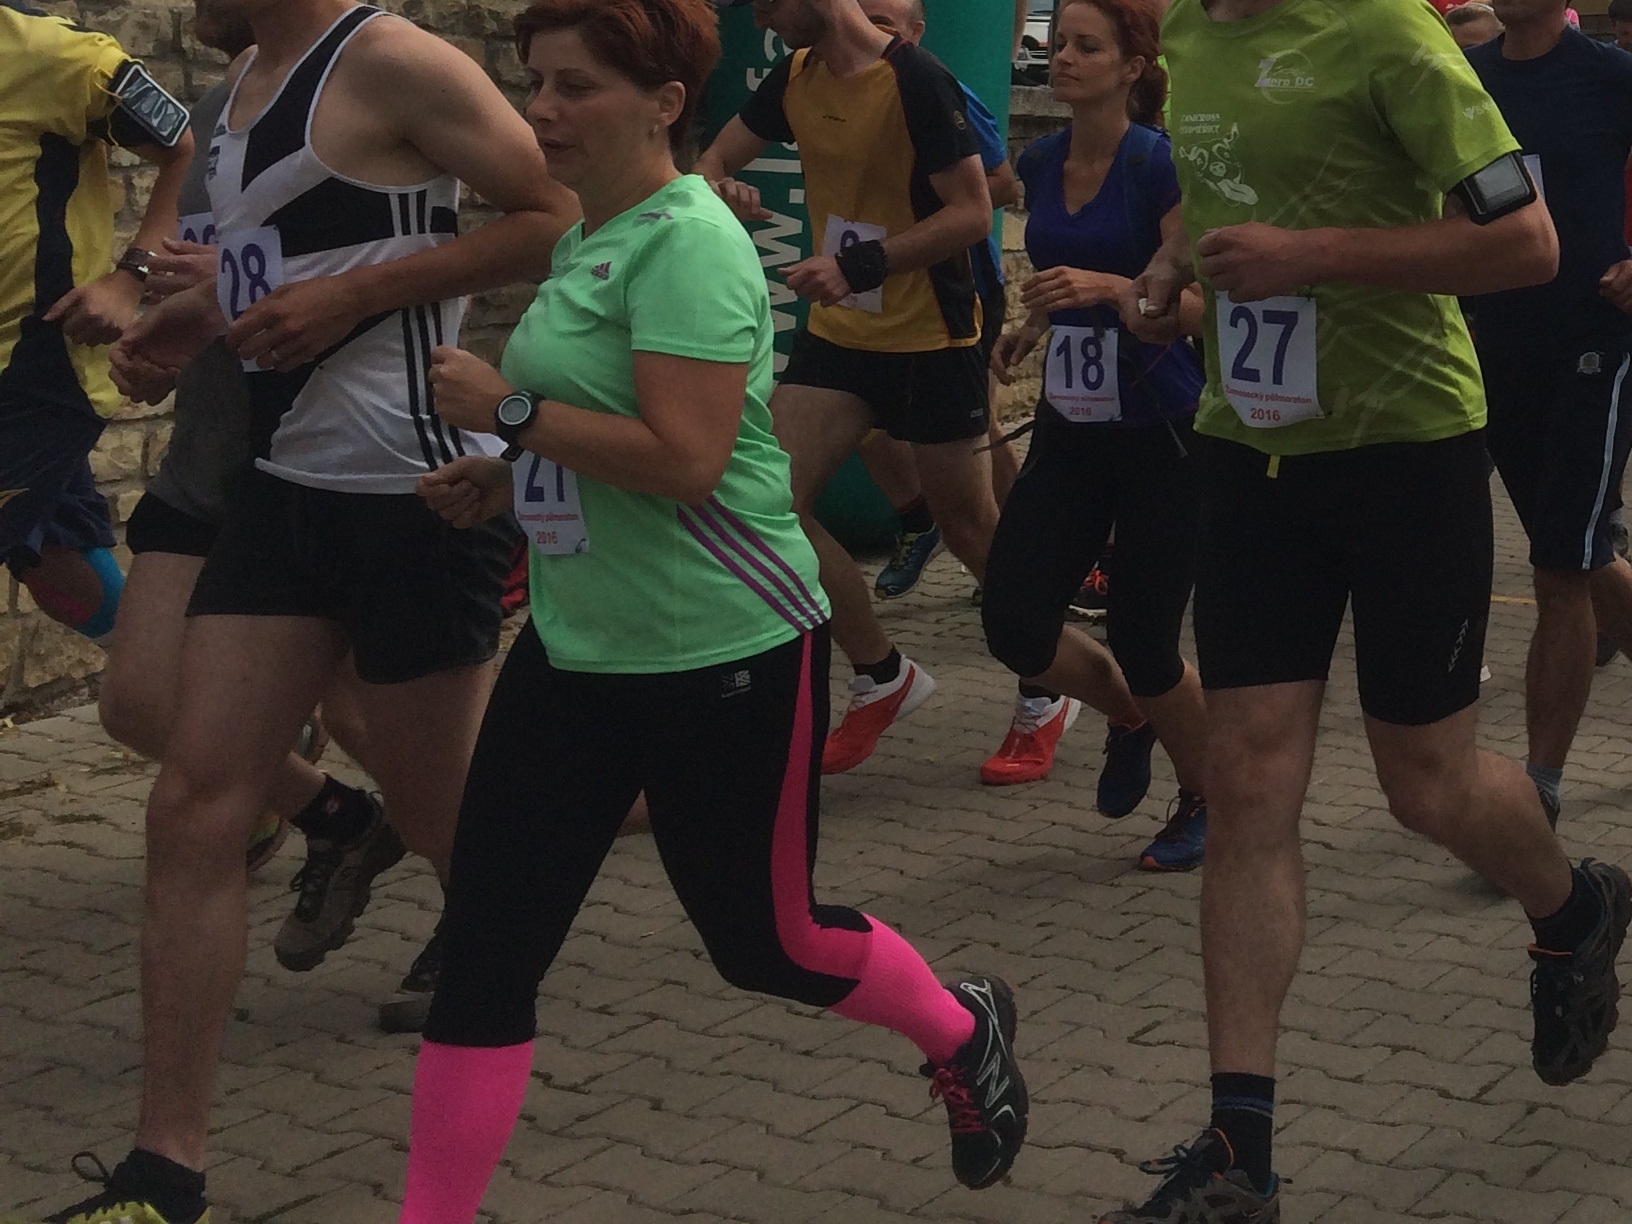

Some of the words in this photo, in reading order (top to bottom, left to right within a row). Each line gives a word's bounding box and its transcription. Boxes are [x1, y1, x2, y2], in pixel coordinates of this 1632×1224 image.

[221, 243, 272, 322] 28
[1056, 334, 1105, 391] 18
[1229, 305, 1299, 386] 27
[1069, 406, 1093, 416] 2016
[1250, 407, 1281, 422] 2016
[536, 530, 558, 544] 2016
